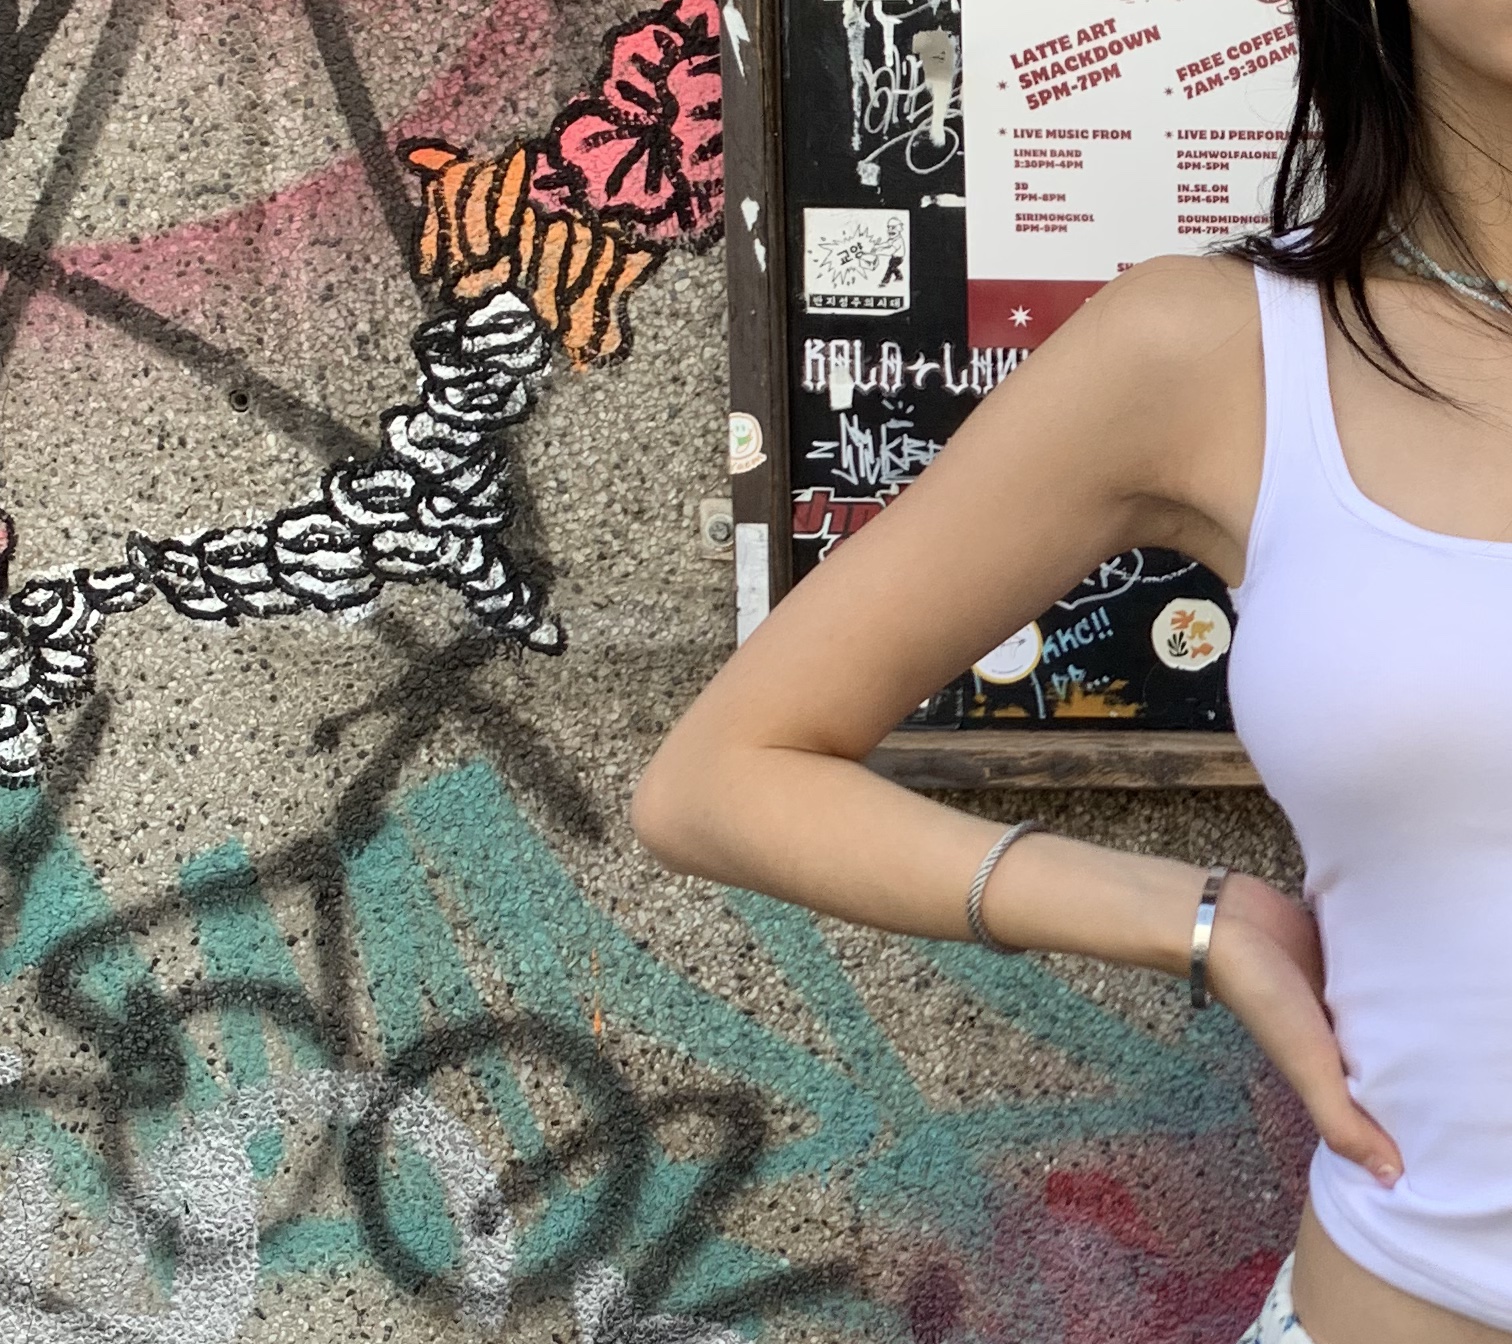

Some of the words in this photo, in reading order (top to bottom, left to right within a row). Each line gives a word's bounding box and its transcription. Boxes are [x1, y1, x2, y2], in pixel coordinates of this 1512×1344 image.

[1009, 34, 1074, 70] LATTE
[1076, 17, 1118, 46] ART
[1018, 24, 1162, 91] SMACKDOWN
[1175, 51, 1226, 83] FREE
[1226, 20, 1297, 61] COFFEE
[1182, 41, 1298, 101] 7AM-9:30AM
[1024, 62, 1122, 111] 5PM-7PM
